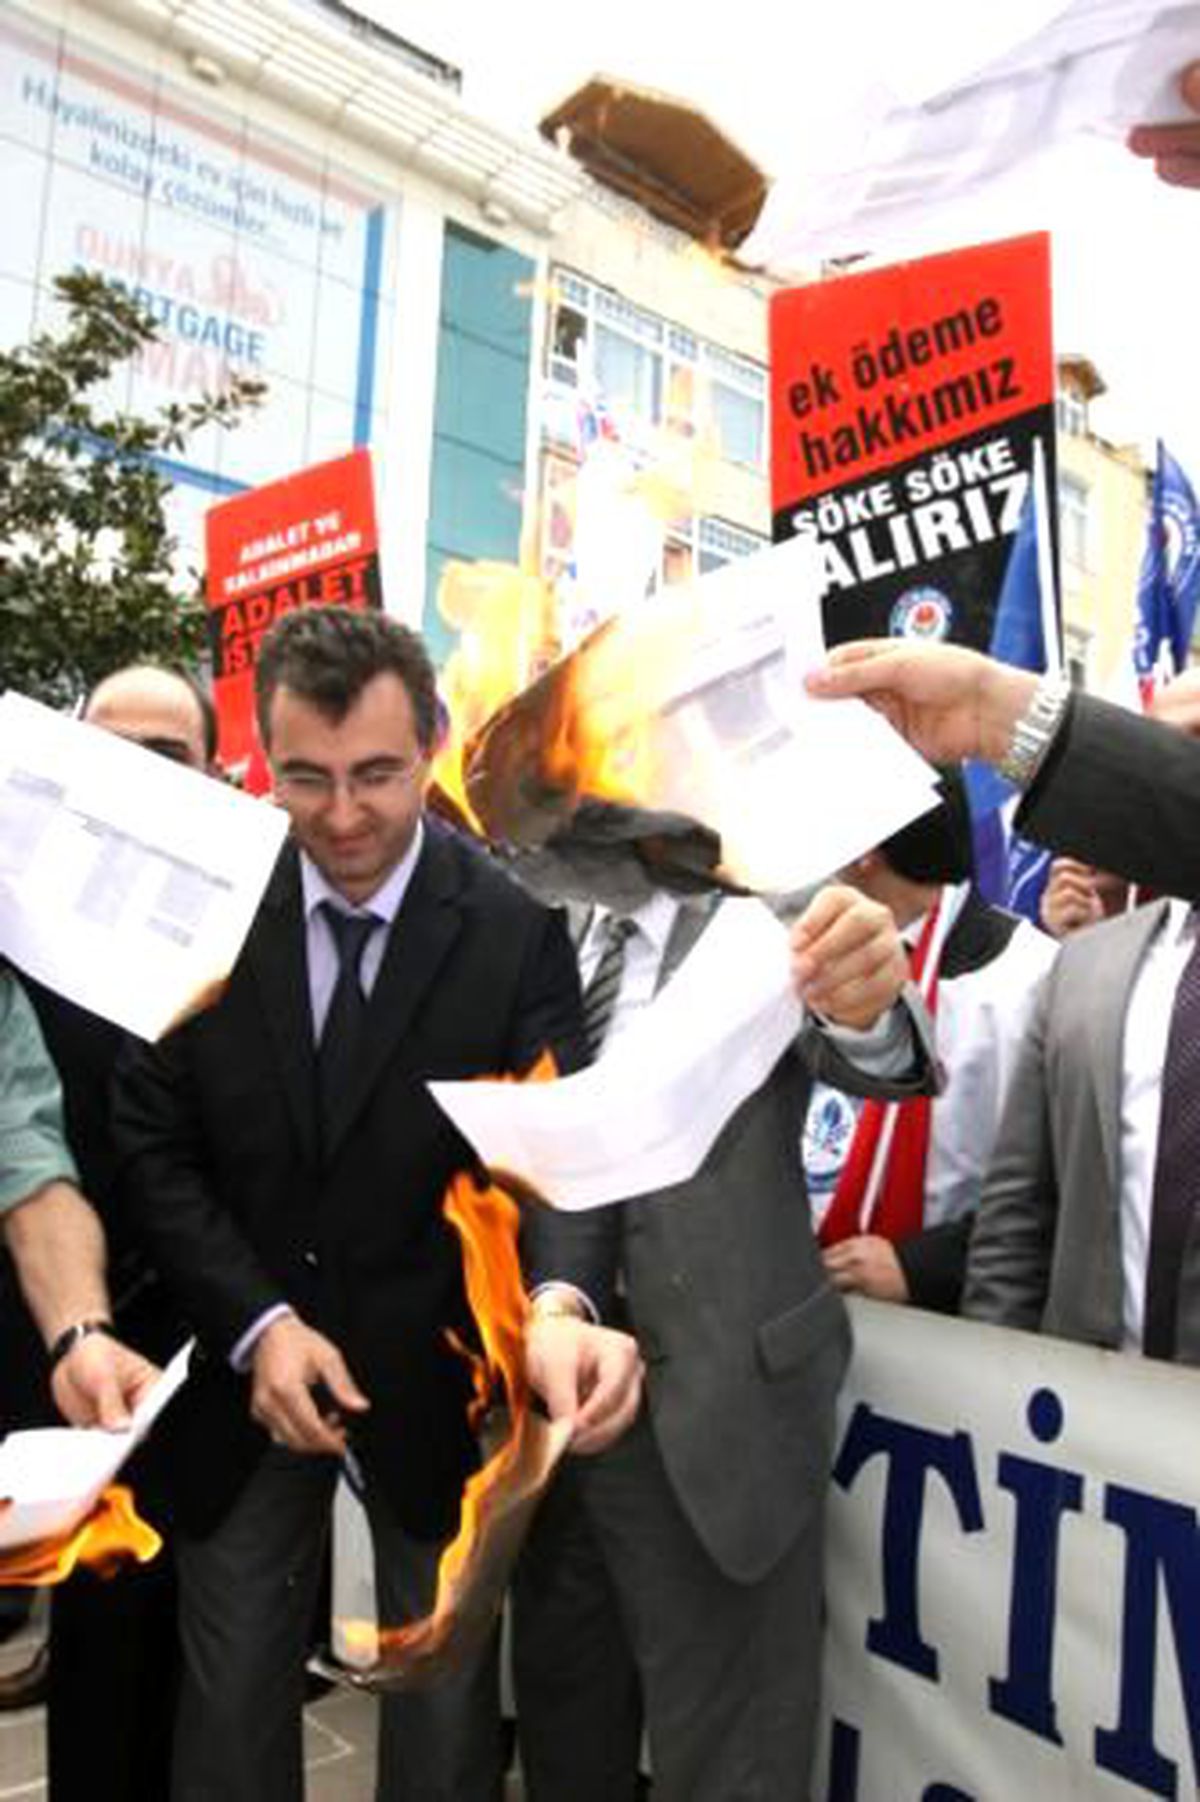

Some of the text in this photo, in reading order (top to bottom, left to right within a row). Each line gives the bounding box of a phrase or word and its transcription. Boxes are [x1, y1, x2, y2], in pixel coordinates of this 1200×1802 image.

[788, 297, 1004, 419] ek ödeme
[799, 357, 1023, 478] hakkımız
[792, 438, 1017, 536] SÖKE SÖKE
[816, 472, 1031, 597] ALIRIZ
[222, 559, 368, 634] ADALET
